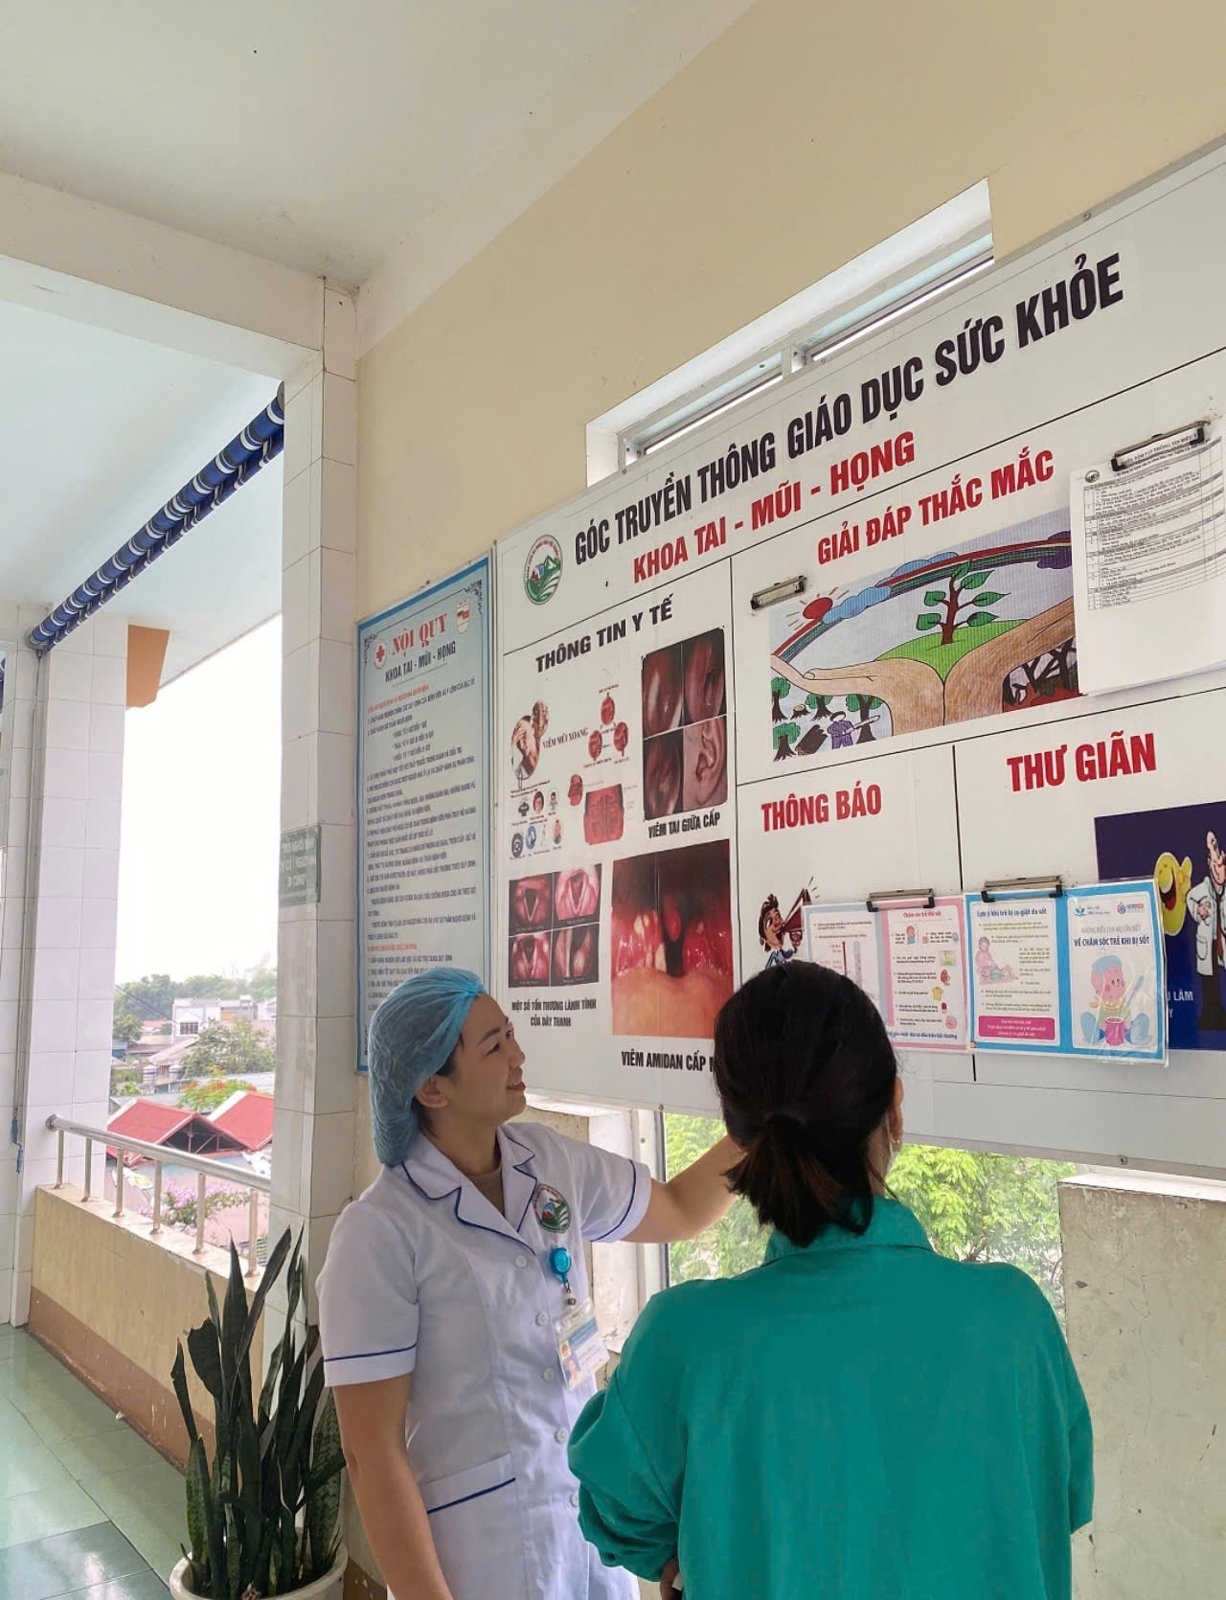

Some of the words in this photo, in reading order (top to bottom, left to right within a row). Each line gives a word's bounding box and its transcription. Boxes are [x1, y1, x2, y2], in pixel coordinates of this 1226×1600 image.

[575, 518, 610, 565] GÓC
[615, 471, 692, 545] TRUYỀN
[697, 432, 776, 504] THÔNG
[787, 394, 852, 459] GIÁO
[861, 356, 924, 421] DỤC
[935, 314, 1005, 387] SỨC
[1015, 252, 1124, 349] KHỎE
[633, 536, 688, 584] KHOA
[694, 516, 727, 555] TAI
[734, 521, 744, 530] -
[751, 479, 801, 531] MŨI
[810, 484, 821, 496] -
[830, 430, 915, 496] HỌNG
[818, 520, 859, 565] GIẢI
[866, 504, 911, 547] ĐÁP
[918, 474, 983, 526] THẮC
[991, 446, 1054, 499] MẮC
[392, 628, 414, 657] NỘI
[419, 613, 447, 647] QUY
[536, 635, 591, 673] THÔNG
[596, 619, 626, 647] TIN
[632, 612, 643, 632] Y
[649, 593, 673, 625] TẾ
[385, 665, 402, 683] KHOA
[403, 660, 412, 675] TAI
[437, 640, 456, 661] HỌNG
[1007, 744, 1068, 792] THƯ
[1075, 730, 1156, 782] GIÃN
[648, 821, 666, 838] VIÊM
[669, 820, 680, 835] TAI
[682, 814, 701, 832] GIỮA
[703, 808, 720, 828] CẤP
[761, 793, 829, 832] THÔNG
[836, 780, 882, 820] BÁO
[1173, 988, 1194, 1001] LÂM
[621, 1048, 644, 1067] VIÊM
[646, 1052, 683, 1070] AMIDAN
[685, 1050, 706, 1071] CẤP
